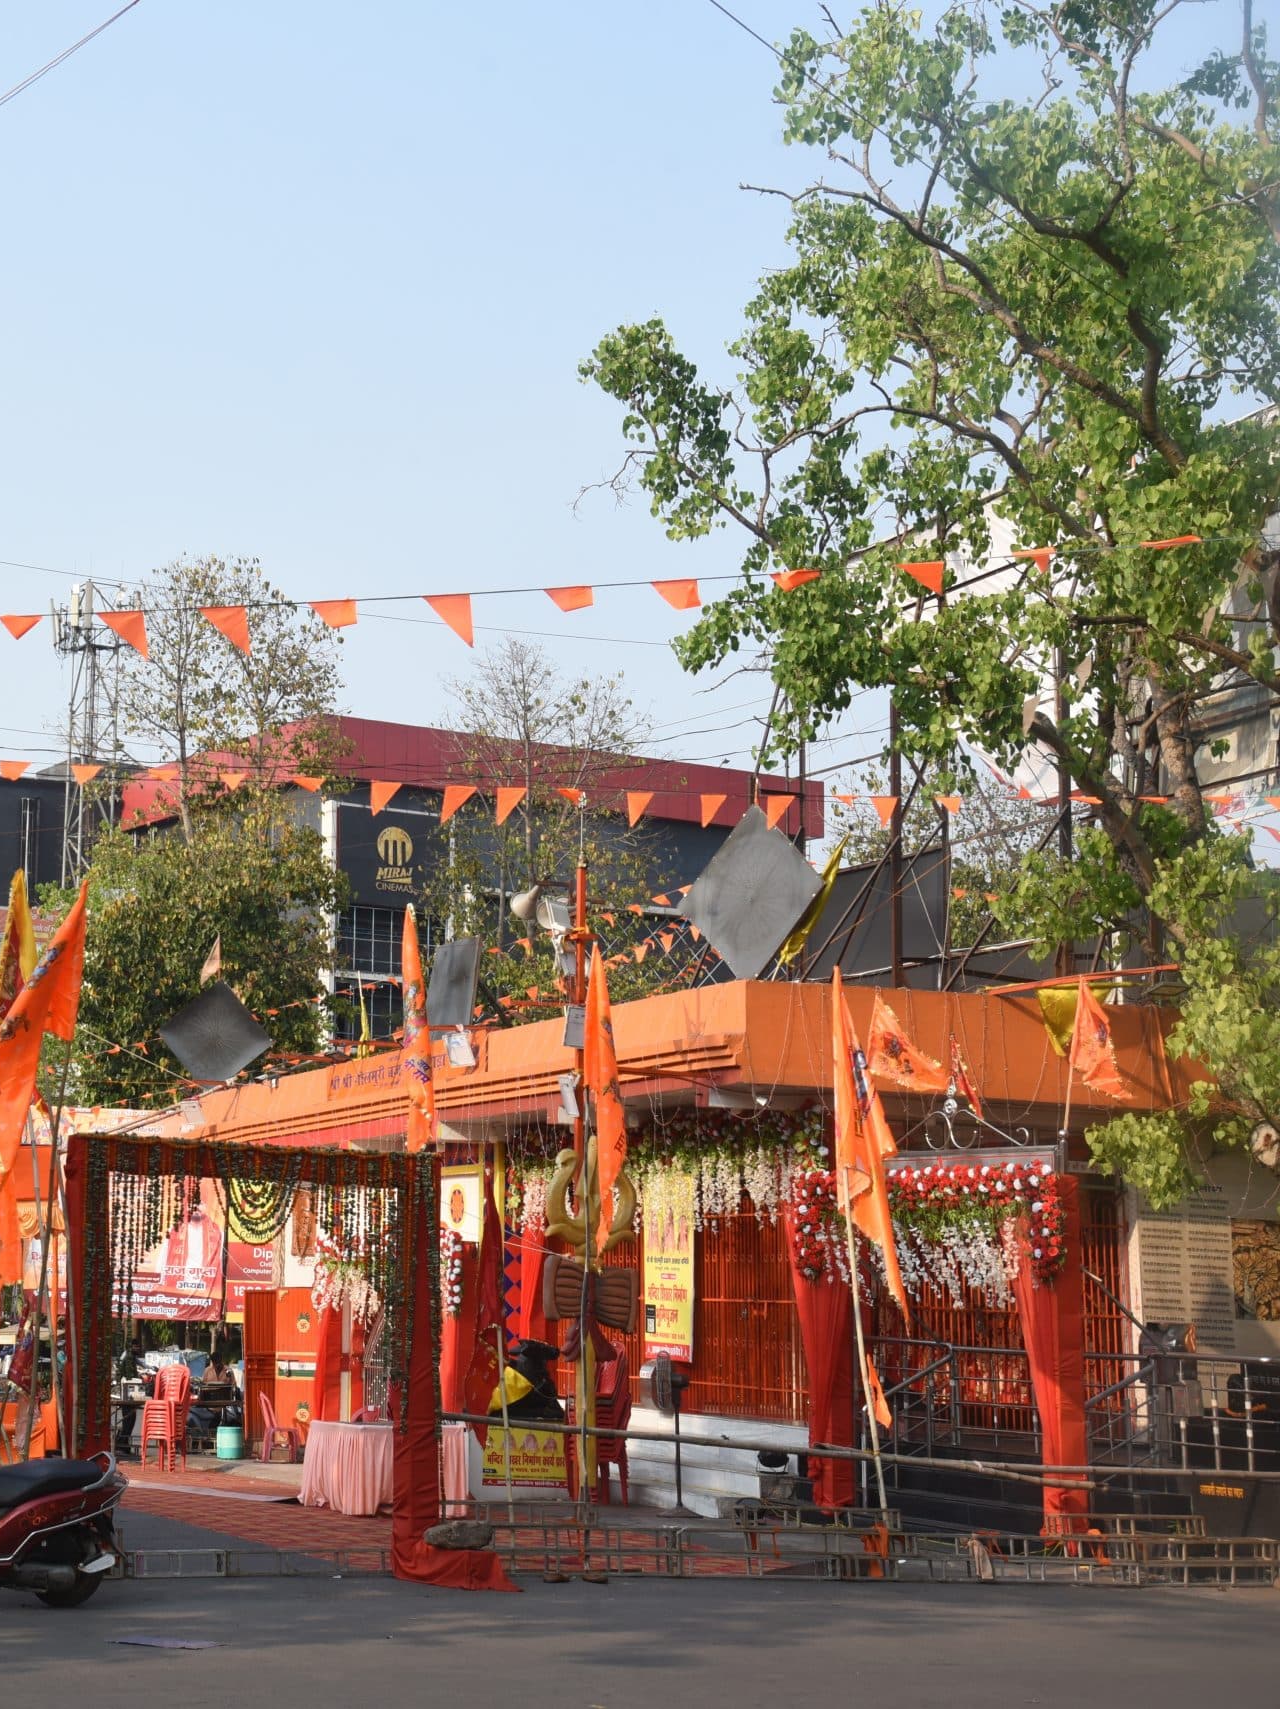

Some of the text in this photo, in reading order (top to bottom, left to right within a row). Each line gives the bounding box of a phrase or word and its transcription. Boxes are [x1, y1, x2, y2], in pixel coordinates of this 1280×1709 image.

[376, 867, 413, 880] MIRAJ
[376, 882, 415, 894] CINEMAS
[242, 1267, 272, 1276] Computer
